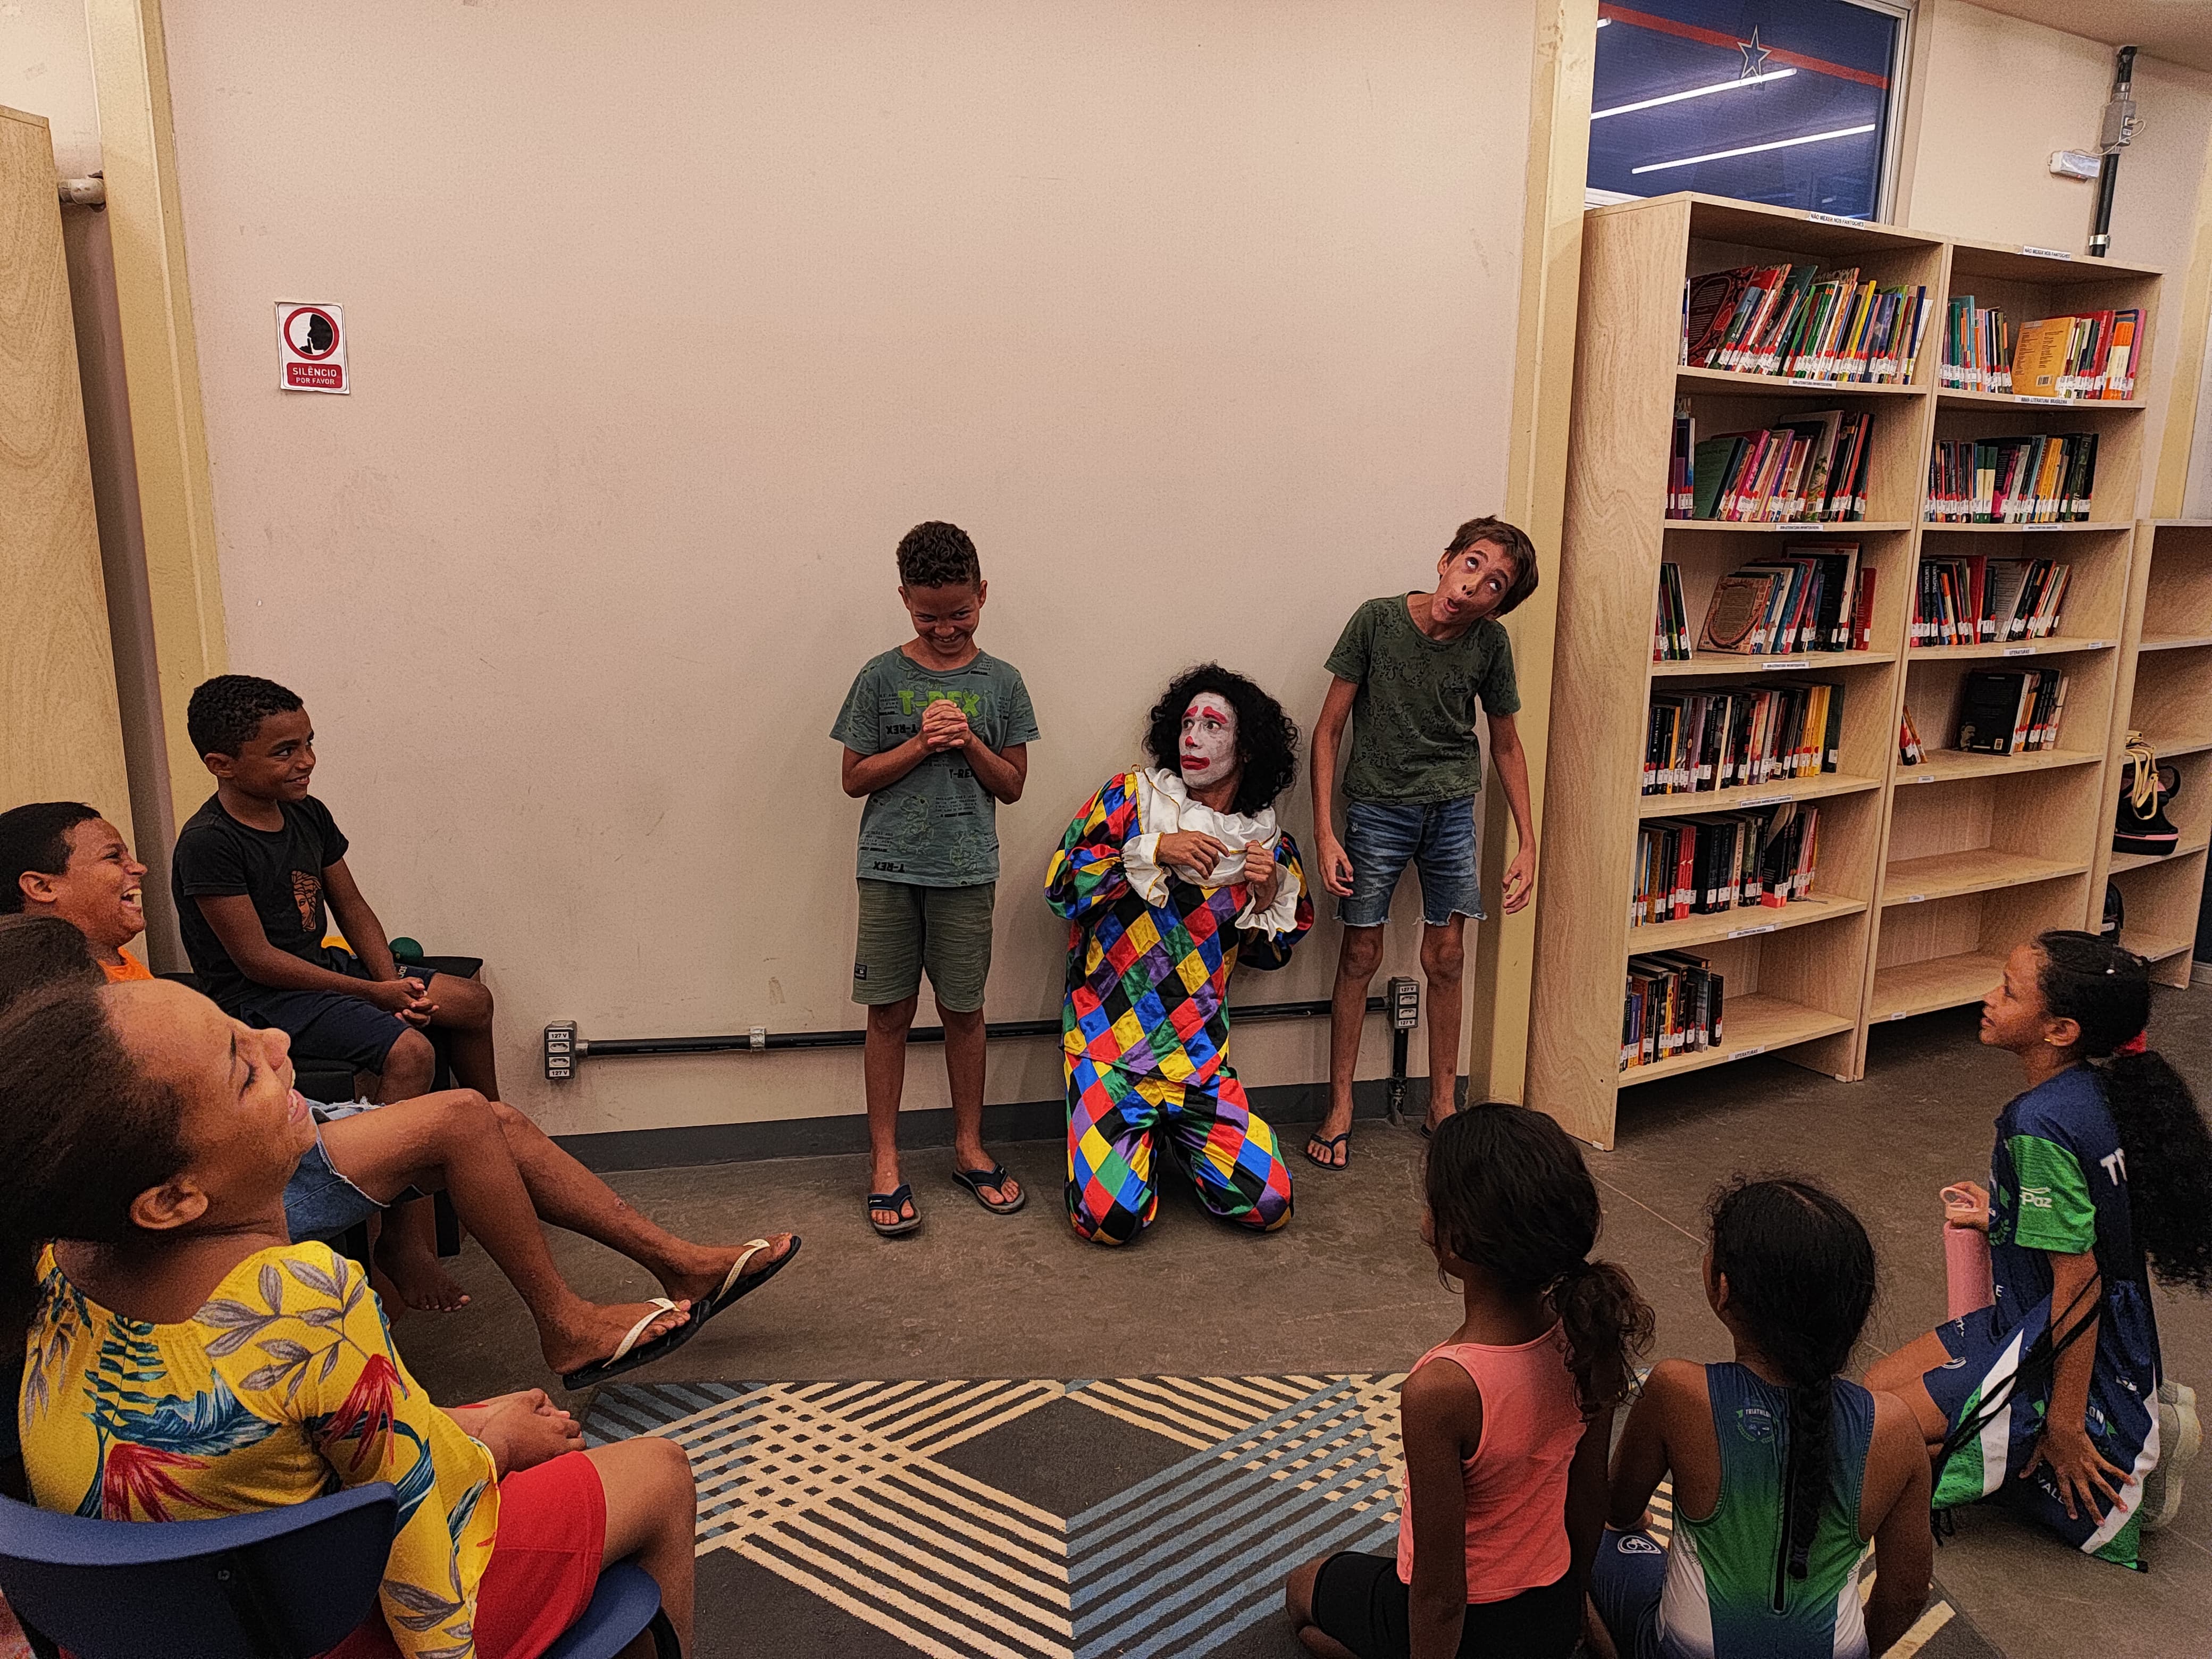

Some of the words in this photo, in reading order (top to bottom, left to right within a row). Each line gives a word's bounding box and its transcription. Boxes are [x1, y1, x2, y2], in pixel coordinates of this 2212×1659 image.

[292, 366, 337, 376] SILÊNCIO
[885, 724, 918, 735] T-REX
[949, 768, 973, 778] T-RE
[873, 860, 905, 873] T-REX
[1735, 1049, 1758, 1059] LITERATURAS
